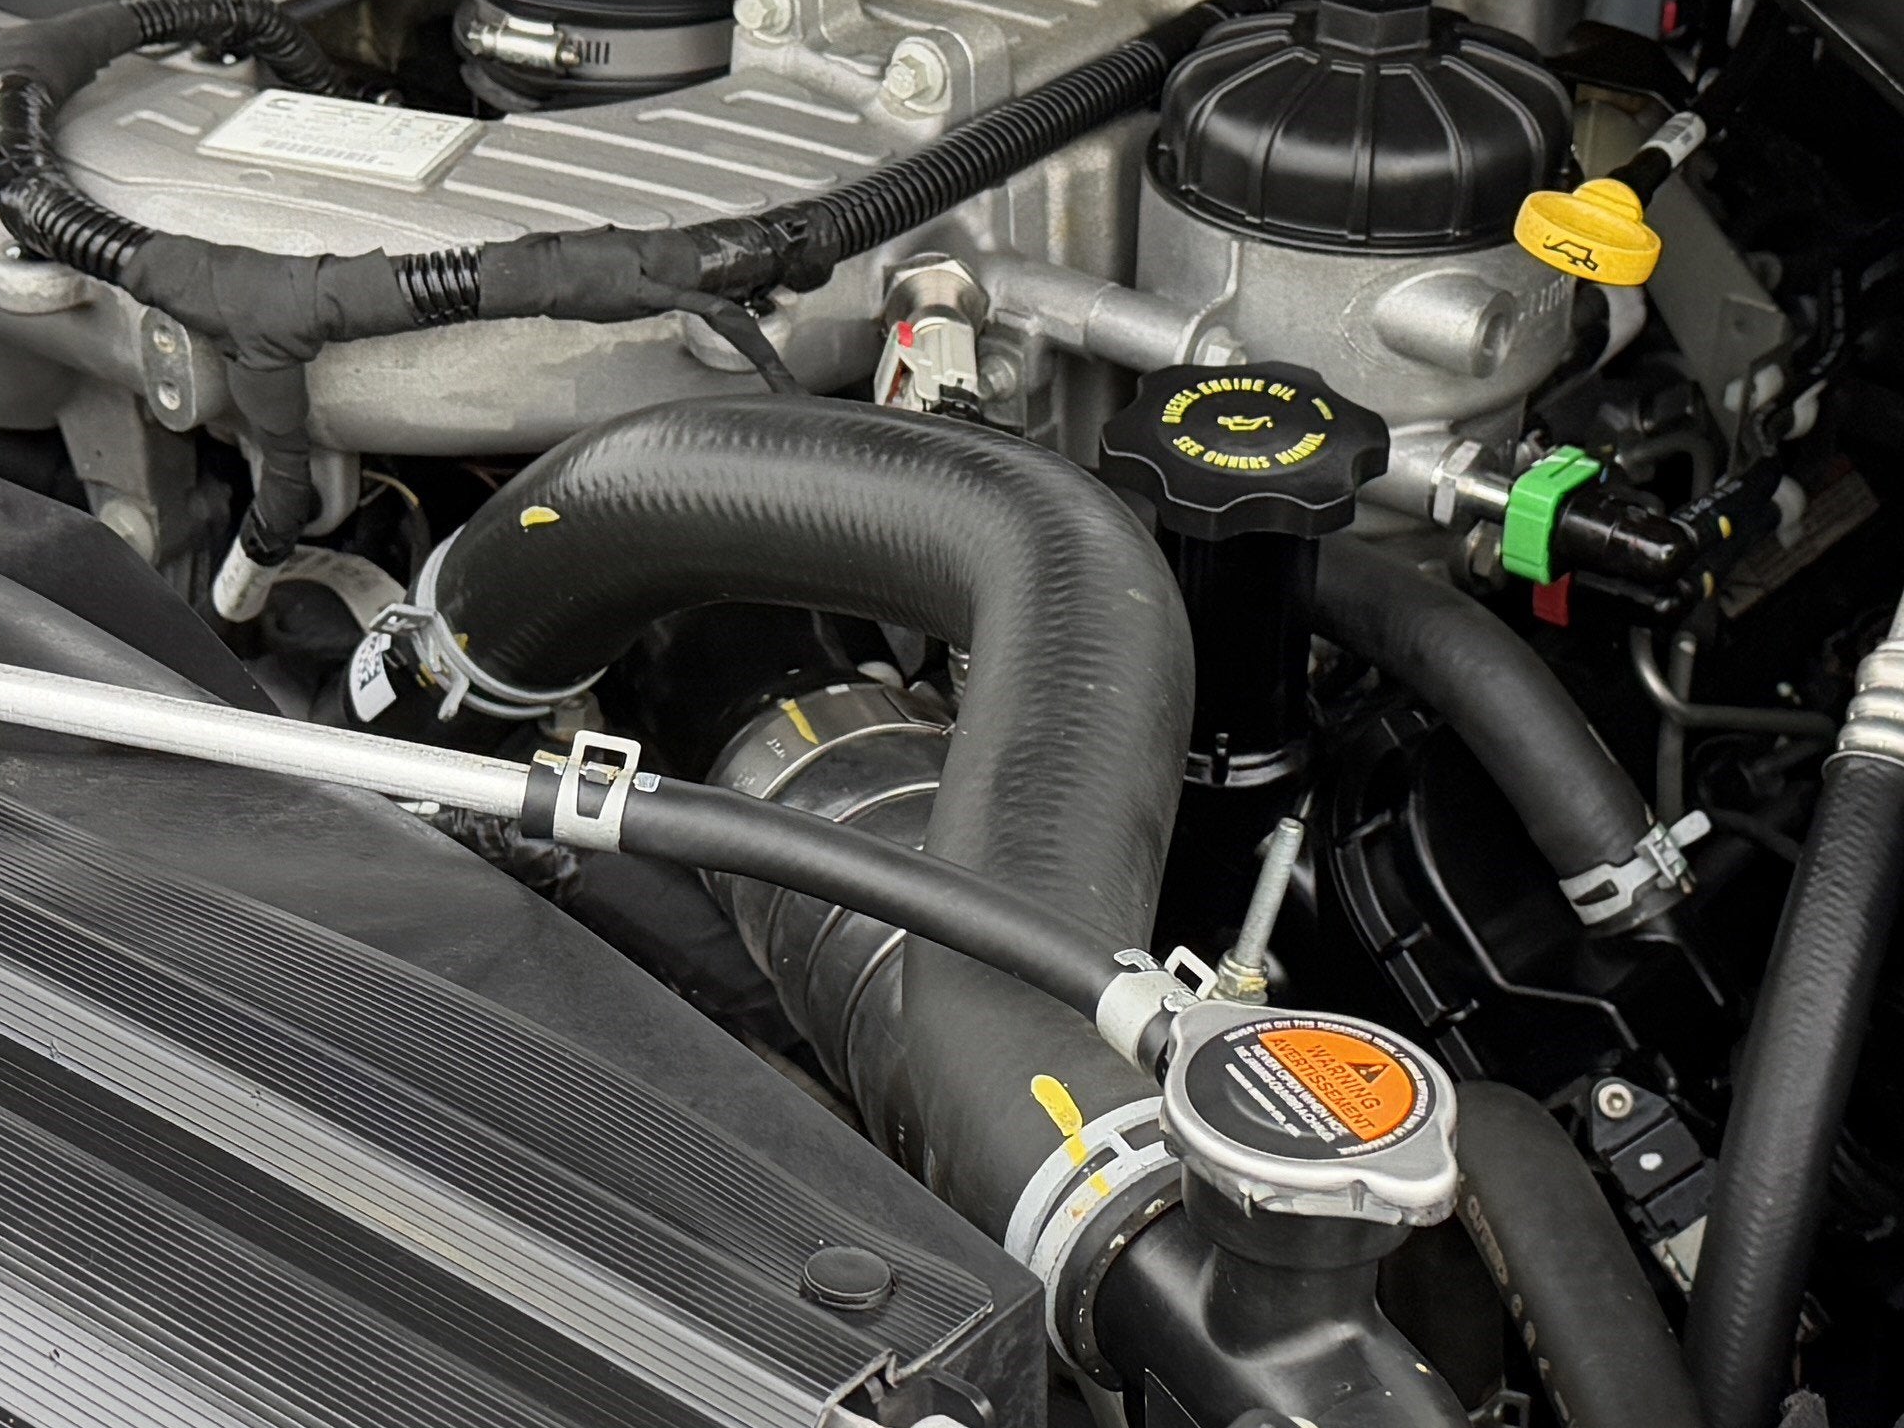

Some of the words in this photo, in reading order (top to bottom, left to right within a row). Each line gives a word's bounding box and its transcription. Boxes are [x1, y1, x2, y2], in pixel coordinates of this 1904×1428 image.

[1162, 389, 1201, 423] DIESEL
[1197, 378, 1265, 395] ENGINE
[1268, 383, 1296, 401] OIL
[1173, 436, 1205, 457] SEE
[1203, 450, 1271, 470] OWNERS
[1275, 433, 1325, 465] MANUAL
[1269, 1037, 1376, 1130] AVERTISSEMENT
[1307, 1044, 1380, 1109] WARNING
